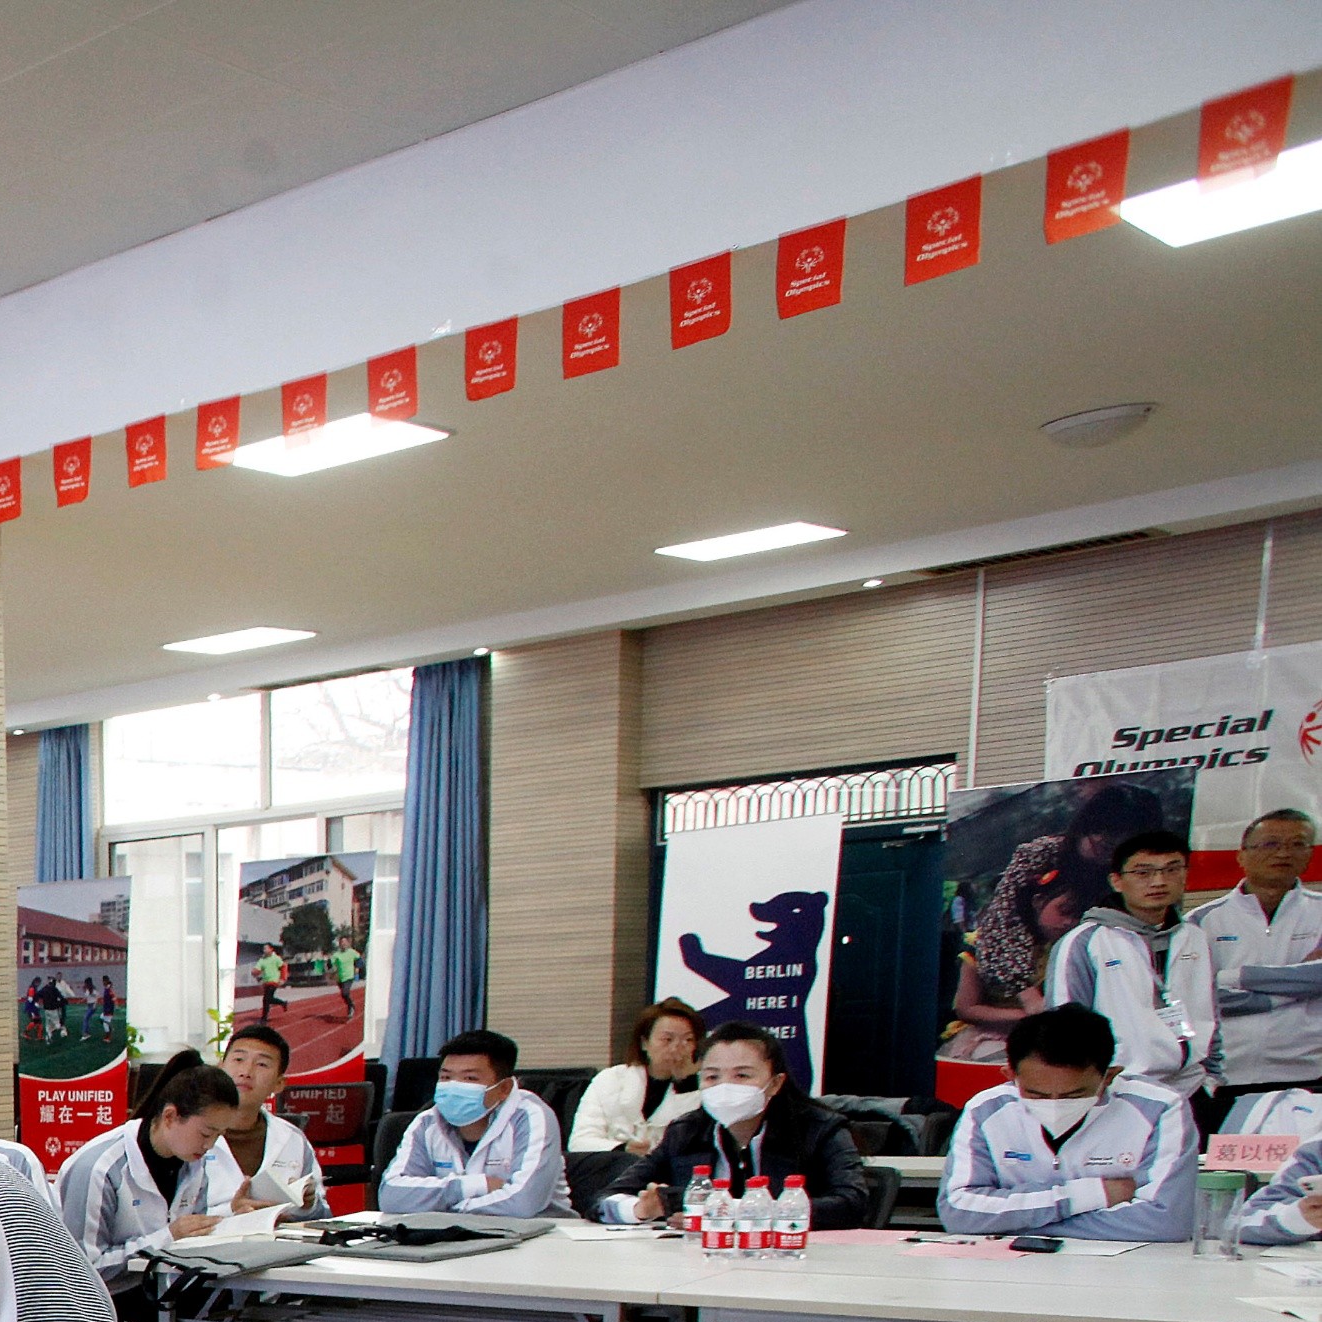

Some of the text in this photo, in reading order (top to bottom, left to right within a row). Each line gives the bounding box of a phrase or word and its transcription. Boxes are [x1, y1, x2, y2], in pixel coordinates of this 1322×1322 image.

[1111, 709, 1274, 751] Special
[745, 963, 803, 979] BERLIN
[746, 995, 788, 1010] HERE
[38, 1090, 114, 1102] PLAY UNIFIED
